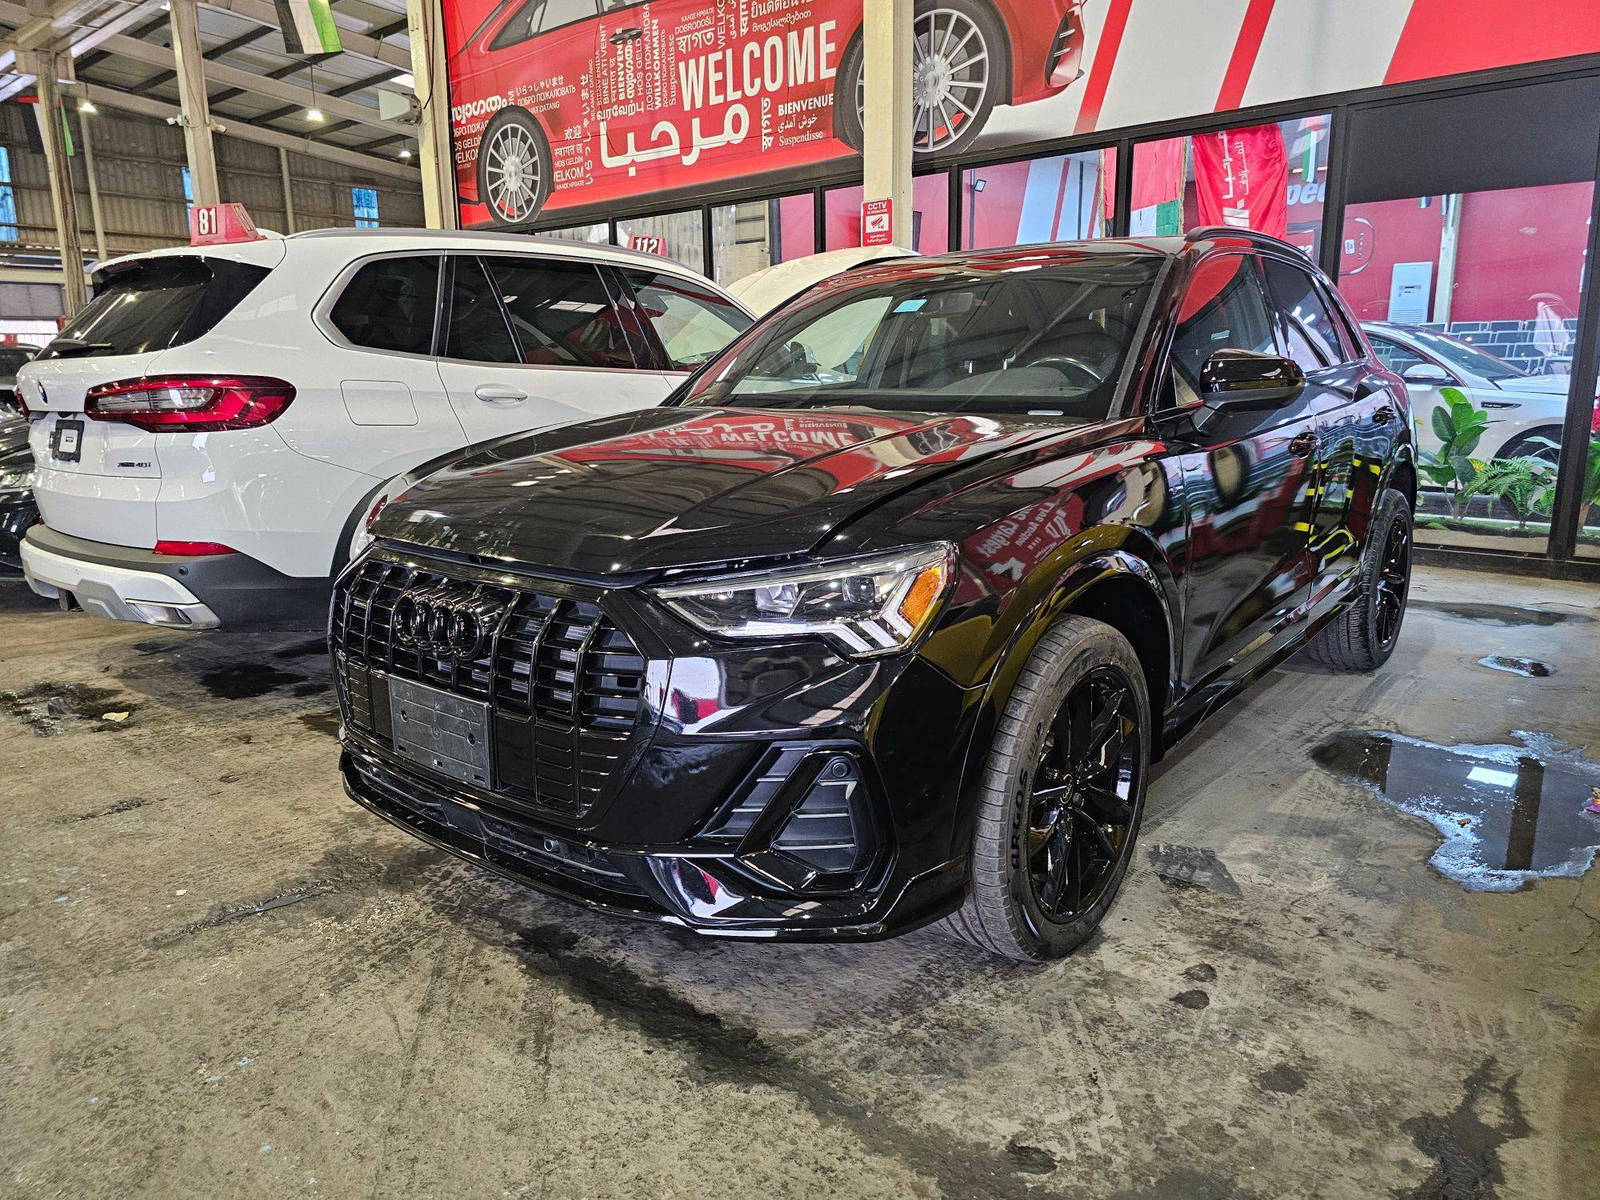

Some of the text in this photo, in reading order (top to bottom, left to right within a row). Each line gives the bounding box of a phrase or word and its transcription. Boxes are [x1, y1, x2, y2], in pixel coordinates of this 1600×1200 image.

[652, 18, 662, 110] WILLKOMMEN
[669, 33, 677, 106] Suspendisse
[679, 20, 837, 111] WELCOME
[778, 93, 834, 116] BIENVENUE
[600, 103, 749, 177] مرحبا
[779, 130, 825, 147] Suspendisse
[867, 201, 888, 211] CCTV
[199, 208, 217, 235] 81
[635, 237, 658, 253] 112
